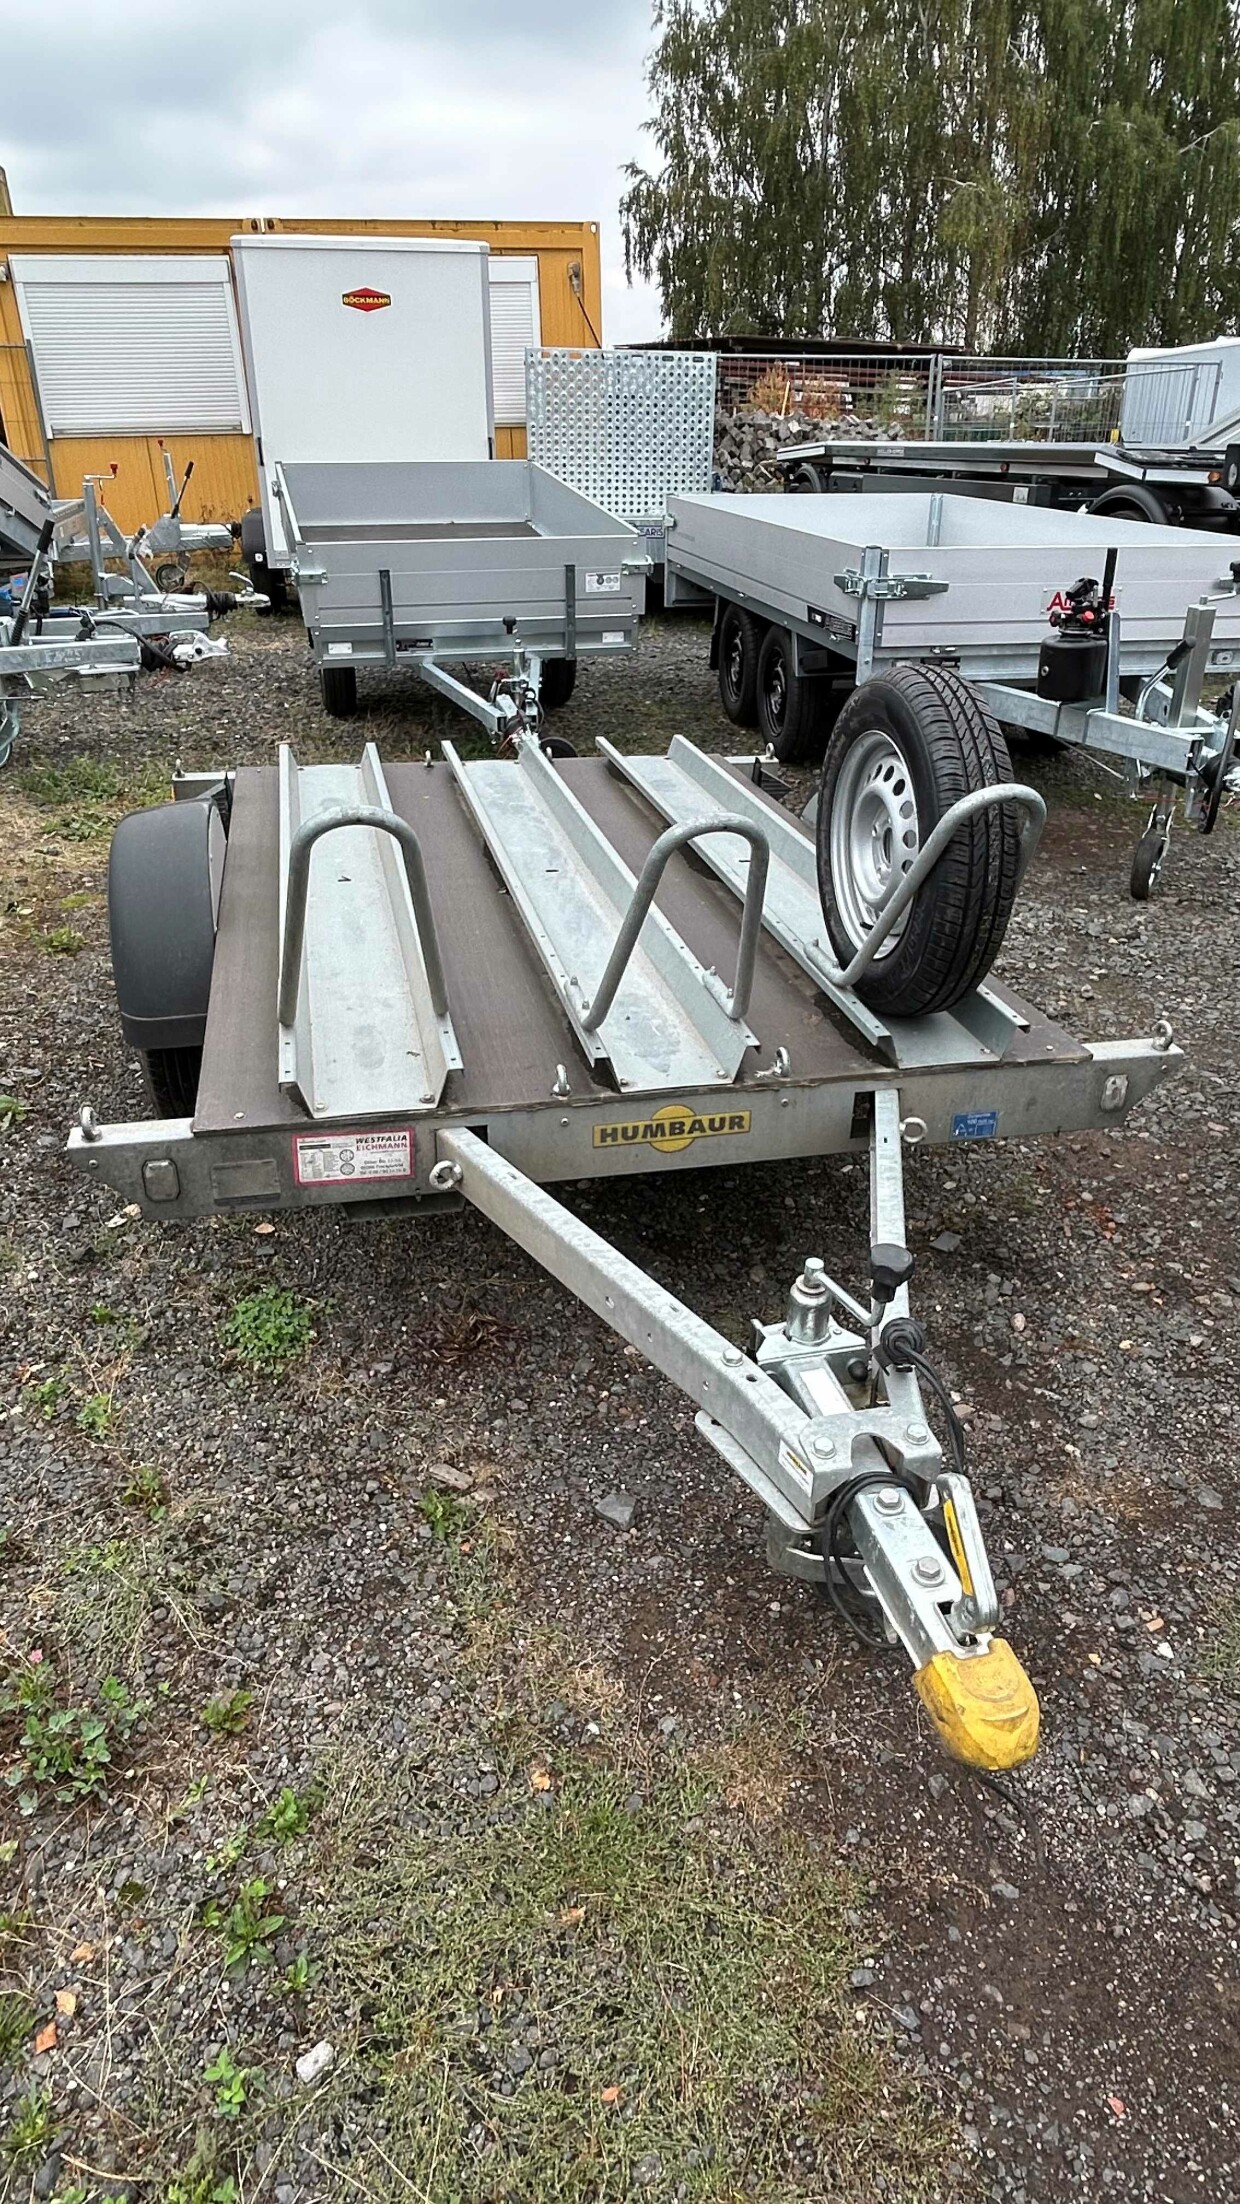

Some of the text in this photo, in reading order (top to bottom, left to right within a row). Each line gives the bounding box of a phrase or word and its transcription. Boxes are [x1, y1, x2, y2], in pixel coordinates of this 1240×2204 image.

[343, 296, 390, 304] BÖCKMANN
[600, 1115, 745, 1143] HUMBAUR
[355, 1135, 407, 1144] WESTFALIA
[356, 1143, 407, 1151] EICHMANN
